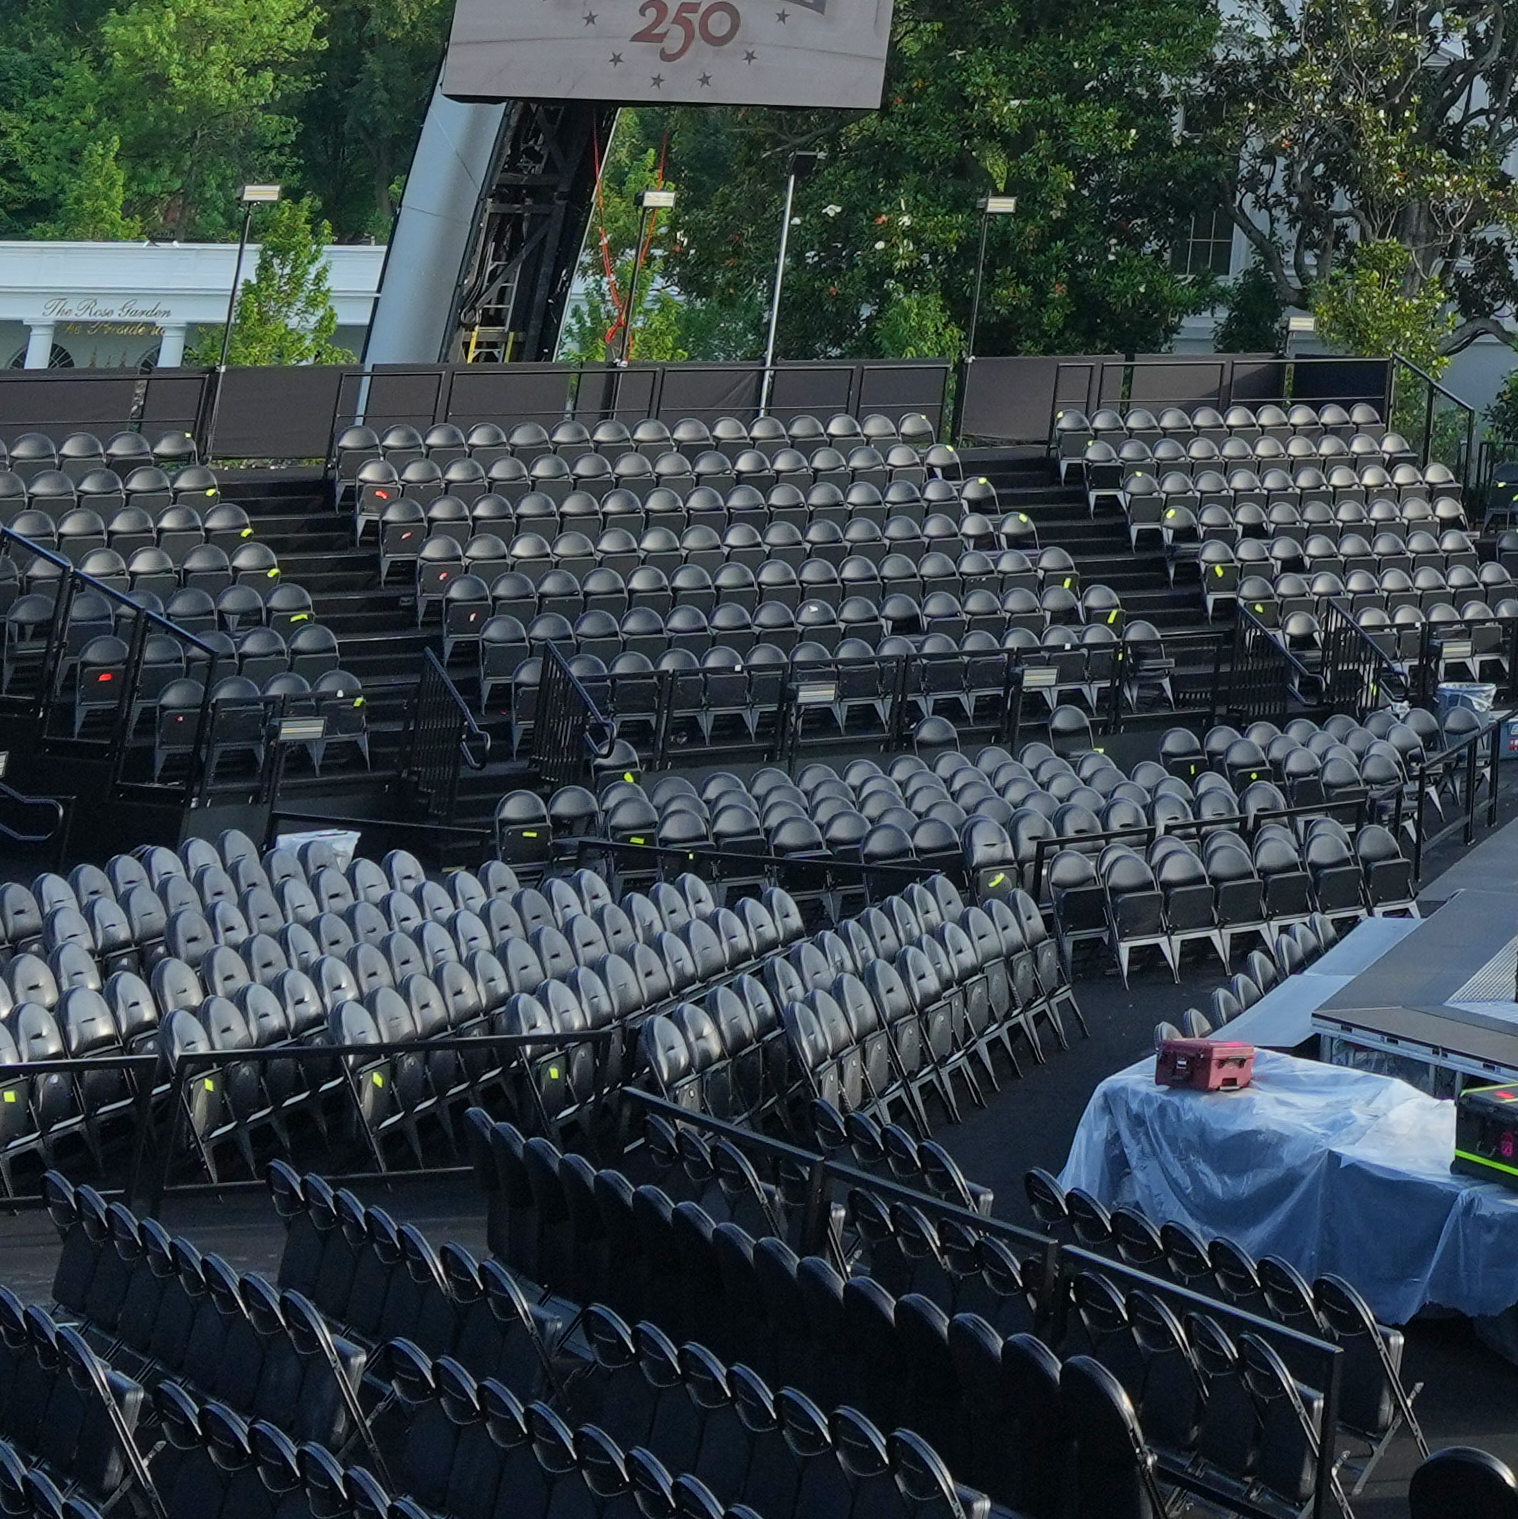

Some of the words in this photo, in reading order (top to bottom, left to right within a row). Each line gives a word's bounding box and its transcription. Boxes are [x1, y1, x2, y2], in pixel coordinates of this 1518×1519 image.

[42, 297, 73, 317] The
[75, 297, 114, 318] Rose
[118, 298, 172, 318] Garden
